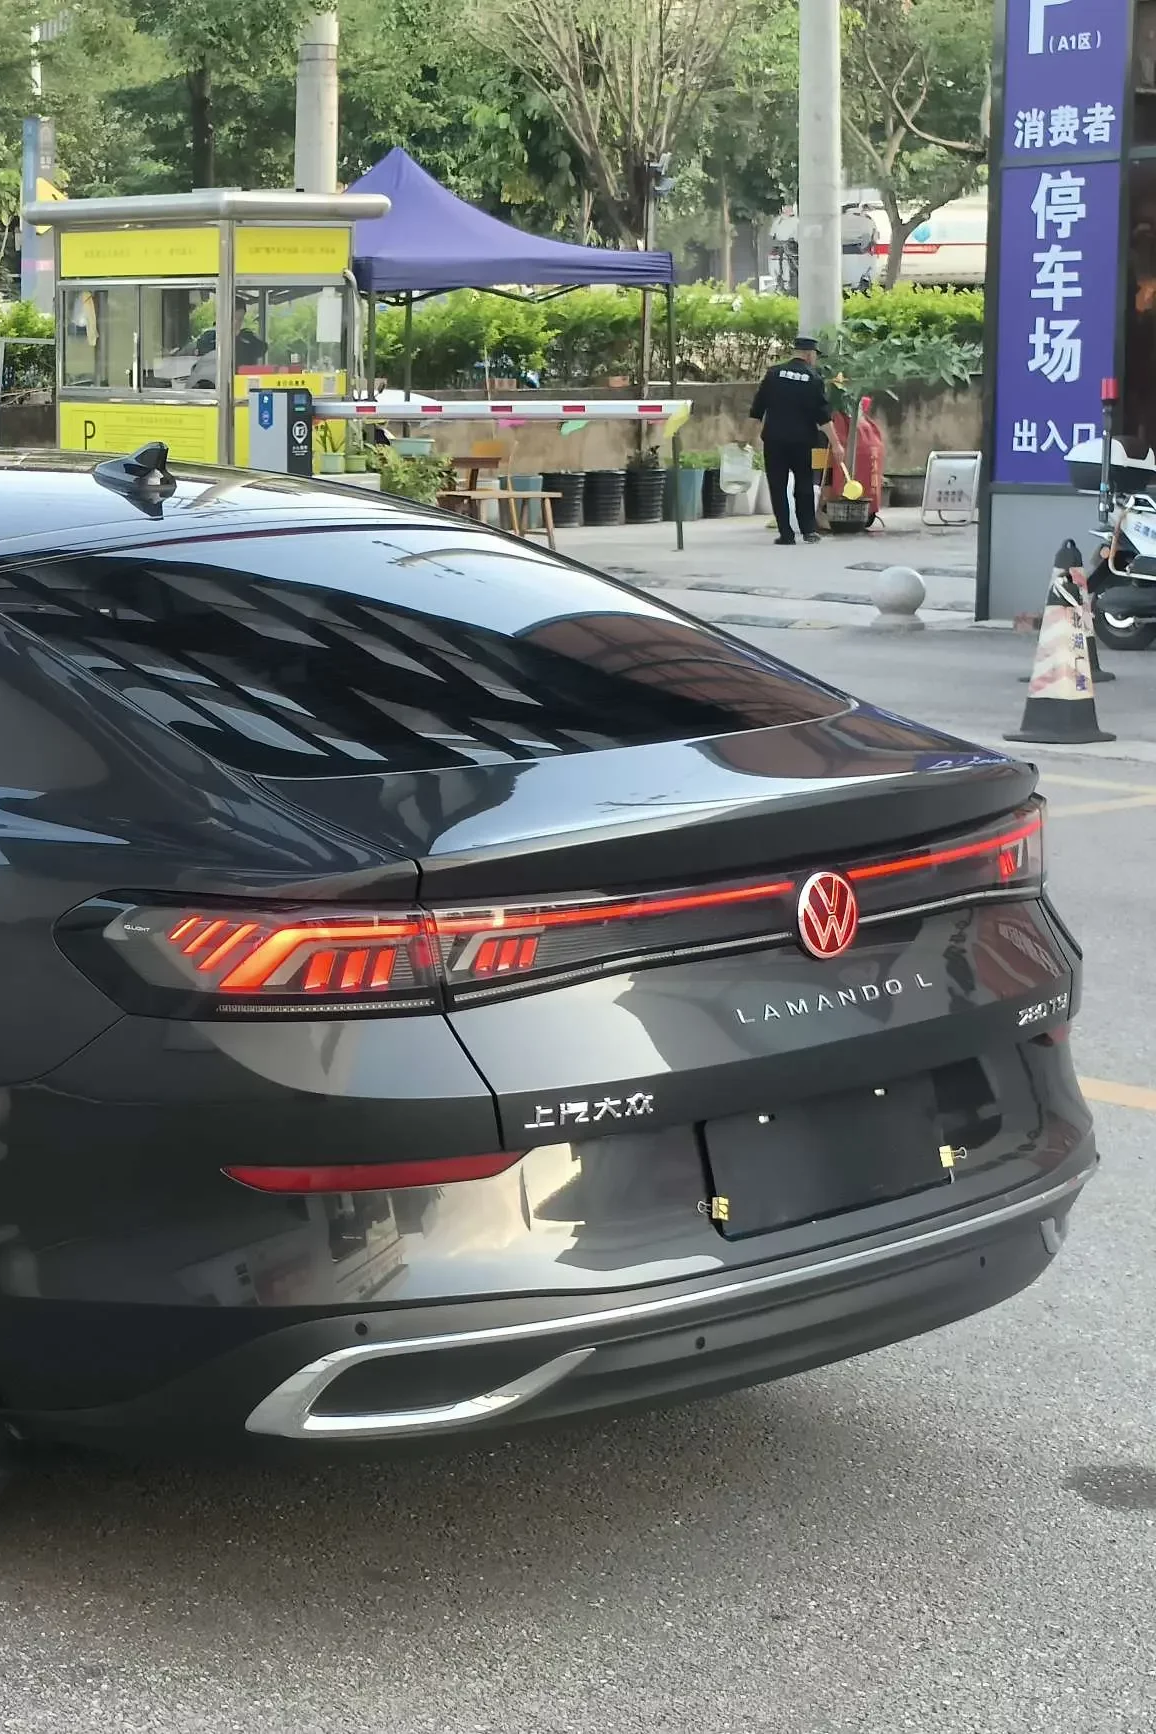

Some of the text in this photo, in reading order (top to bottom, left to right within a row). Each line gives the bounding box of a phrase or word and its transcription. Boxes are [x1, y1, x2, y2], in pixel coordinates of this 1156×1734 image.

[1013, 102, 1116, 149] 消费者
[1028, 169, 1086, 383] 停车场
[1012, 418, 1096, 454] 出入口
[736, 973, 933, 1024] LAMANDO L
[524, 1092, 654, 1129] 上汽大众
